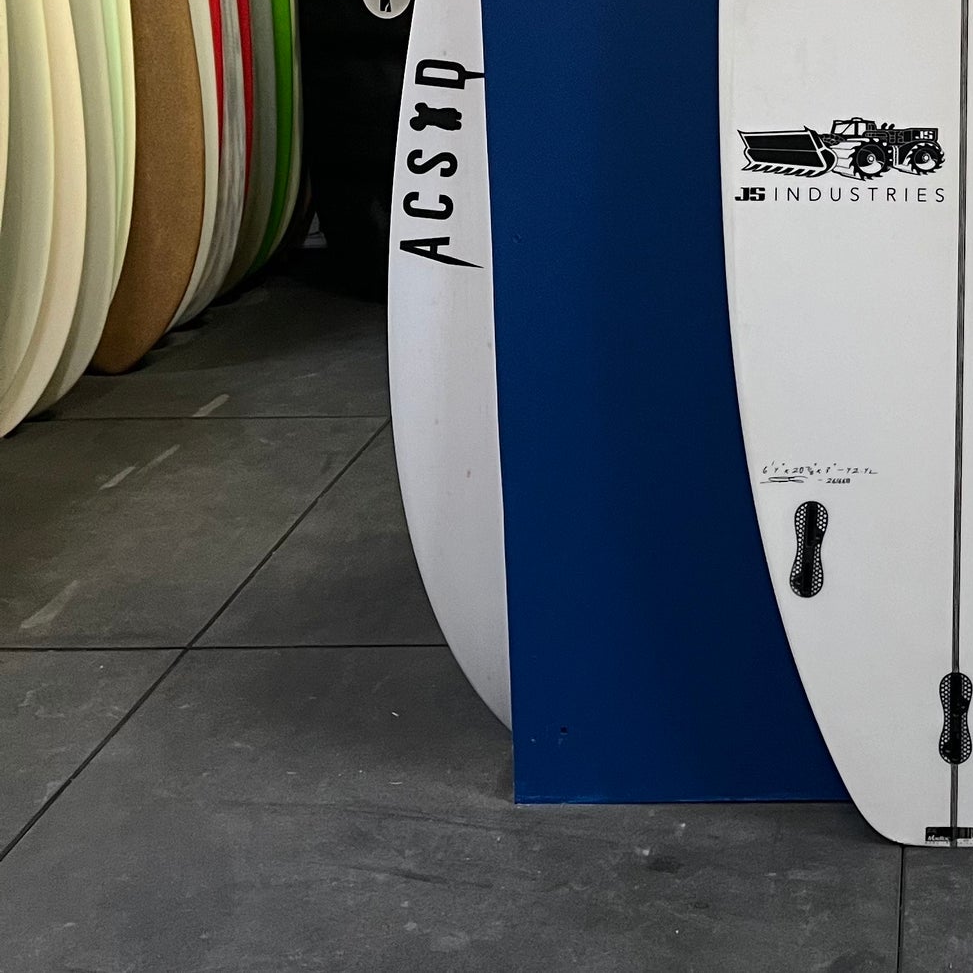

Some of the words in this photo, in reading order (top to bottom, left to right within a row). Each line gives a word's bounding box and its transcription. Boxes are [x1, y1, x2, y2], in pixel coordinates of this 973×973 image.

[915, 130, 934, 140] JS
[735, 187, 766, 202] JS
[774, 187, 945, 203] INDUSTRIES
